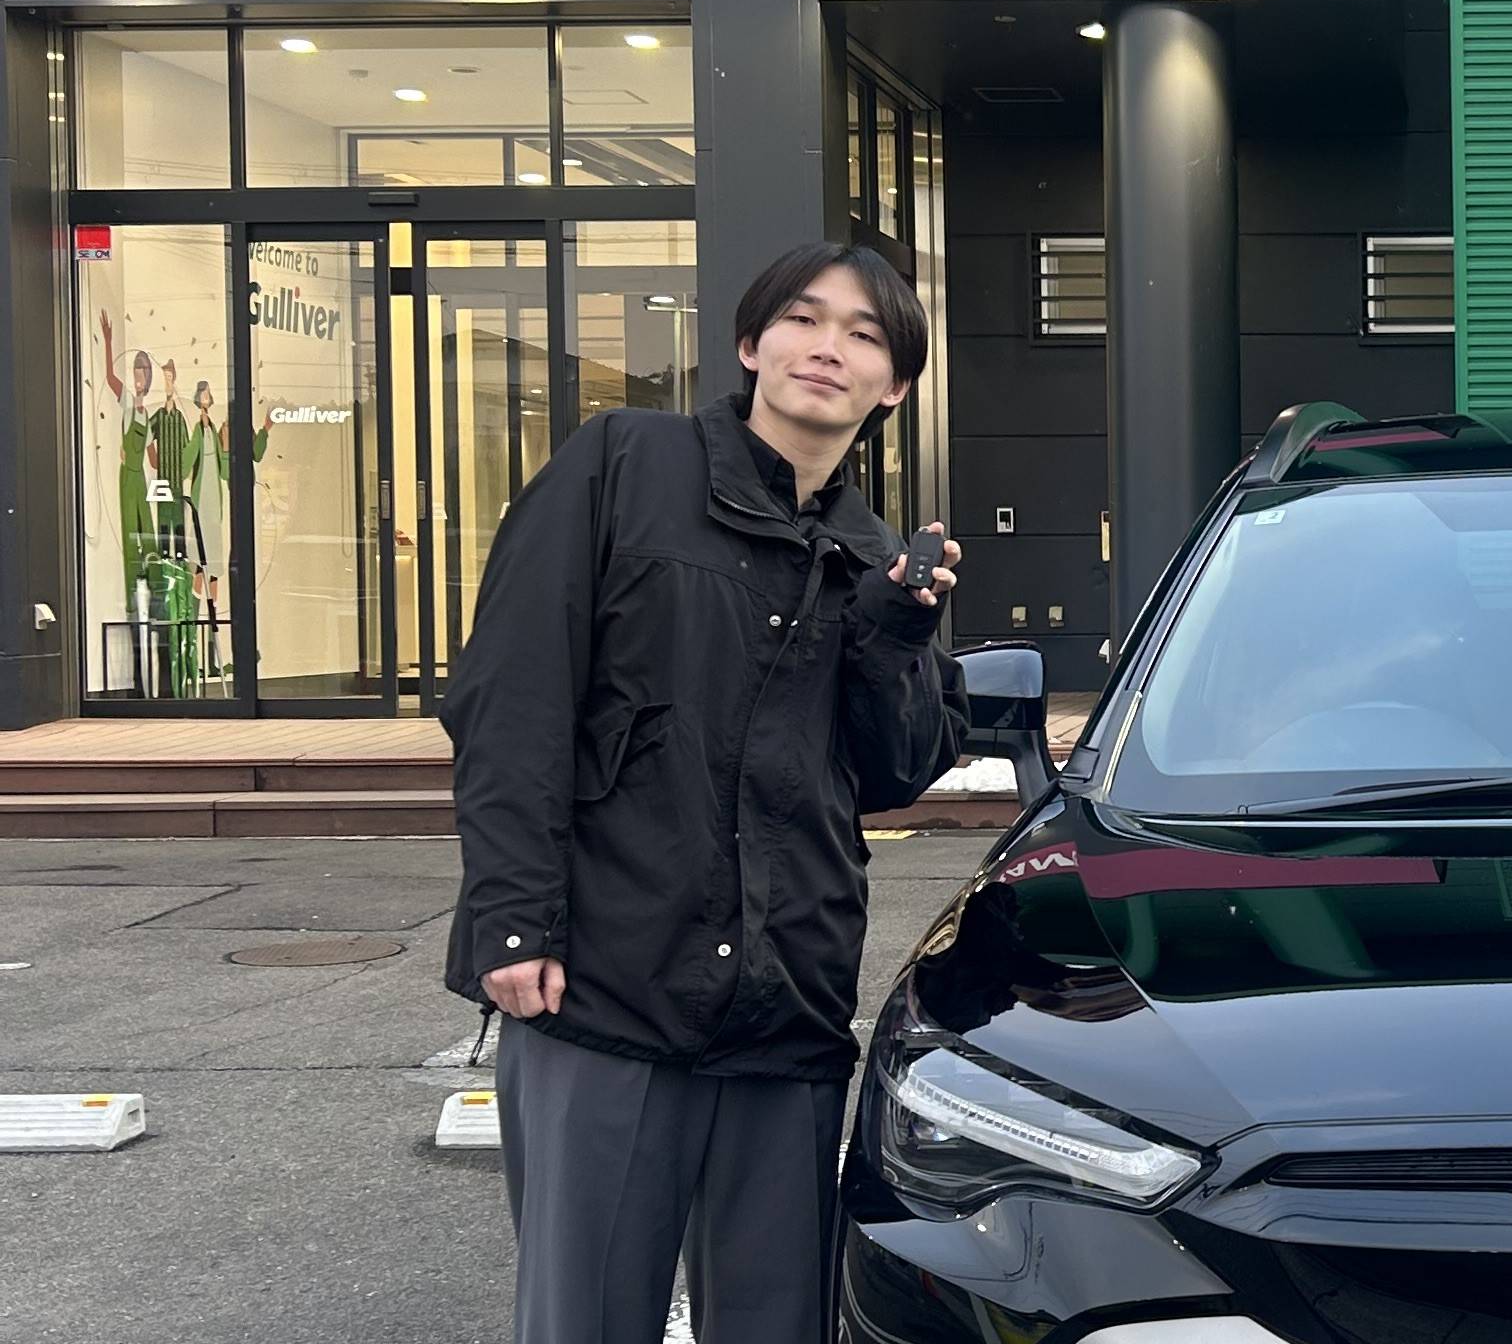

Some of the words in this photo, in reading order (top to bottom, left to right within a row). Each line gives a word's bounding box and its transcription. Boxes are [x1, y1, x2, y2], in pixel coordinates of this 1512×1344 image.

[306, 252, 319, 276] to
[248, 281, 340, 340] Gulliver
[270, 406, 352, 423] Gulliver
